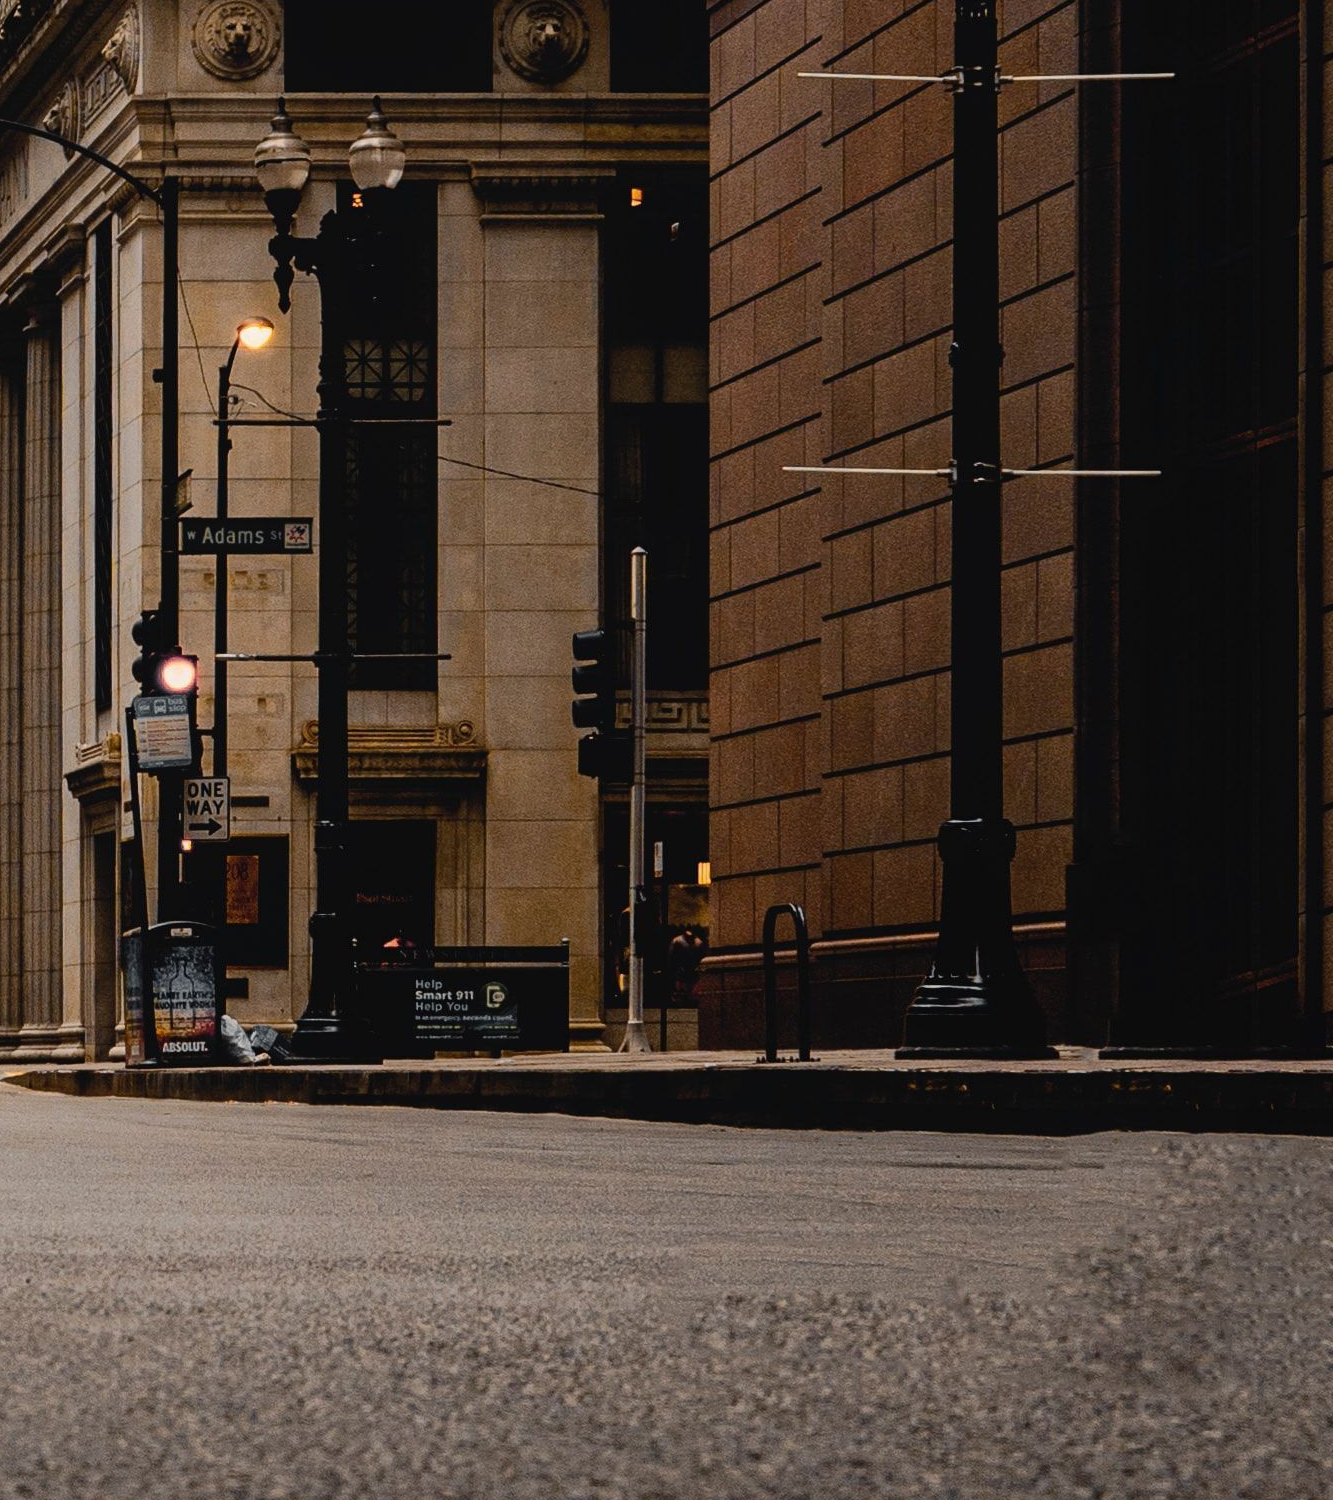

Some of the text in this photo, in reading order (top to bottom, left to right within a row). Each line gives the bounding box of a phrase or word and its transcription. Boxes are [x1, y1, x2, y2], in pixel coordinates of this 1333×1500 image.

[187, 527, 282, 544] W Adams St
[187, 782, 223, 797] ONE
[186, 800, 223, 816] WAY
[415, 979, 443, 990] Help
[415, 990, 474, 1000] Smart 911
[415, 1001, 468, 1012] Help You
[162, 1041, 208, 1053] ABSOLUT.
